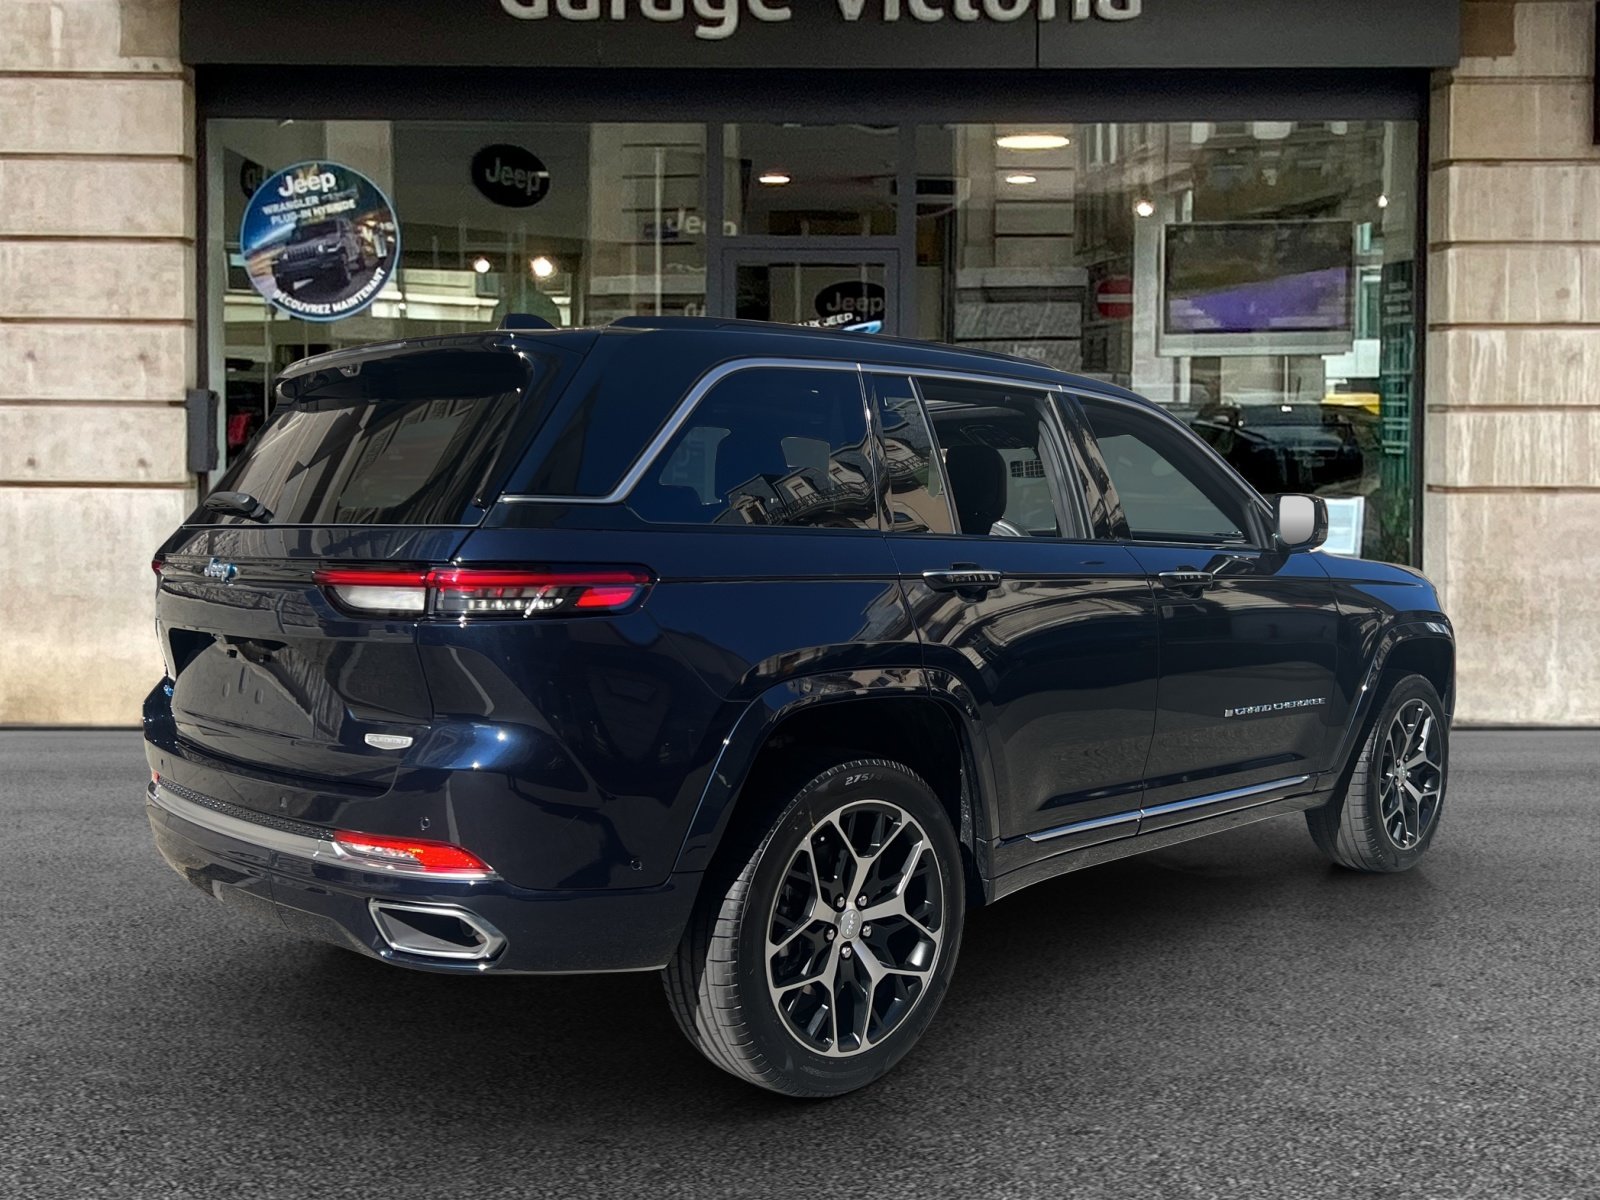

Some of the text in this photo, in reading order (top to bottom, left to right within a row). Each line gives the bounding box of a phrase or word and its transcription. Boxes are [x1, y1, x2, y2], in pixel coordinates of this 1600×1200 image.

[278, 172, 336, 197] Jeep
[485, 157, 541, 196] Jeep
[262, 195, 320, 215] WRANGLER
[331, 266, 386, 312] MAINTENANT
[826, 291, 884, 317] Jeep
[1234, 697, 1327, 716] GRAND CHEROKEE
